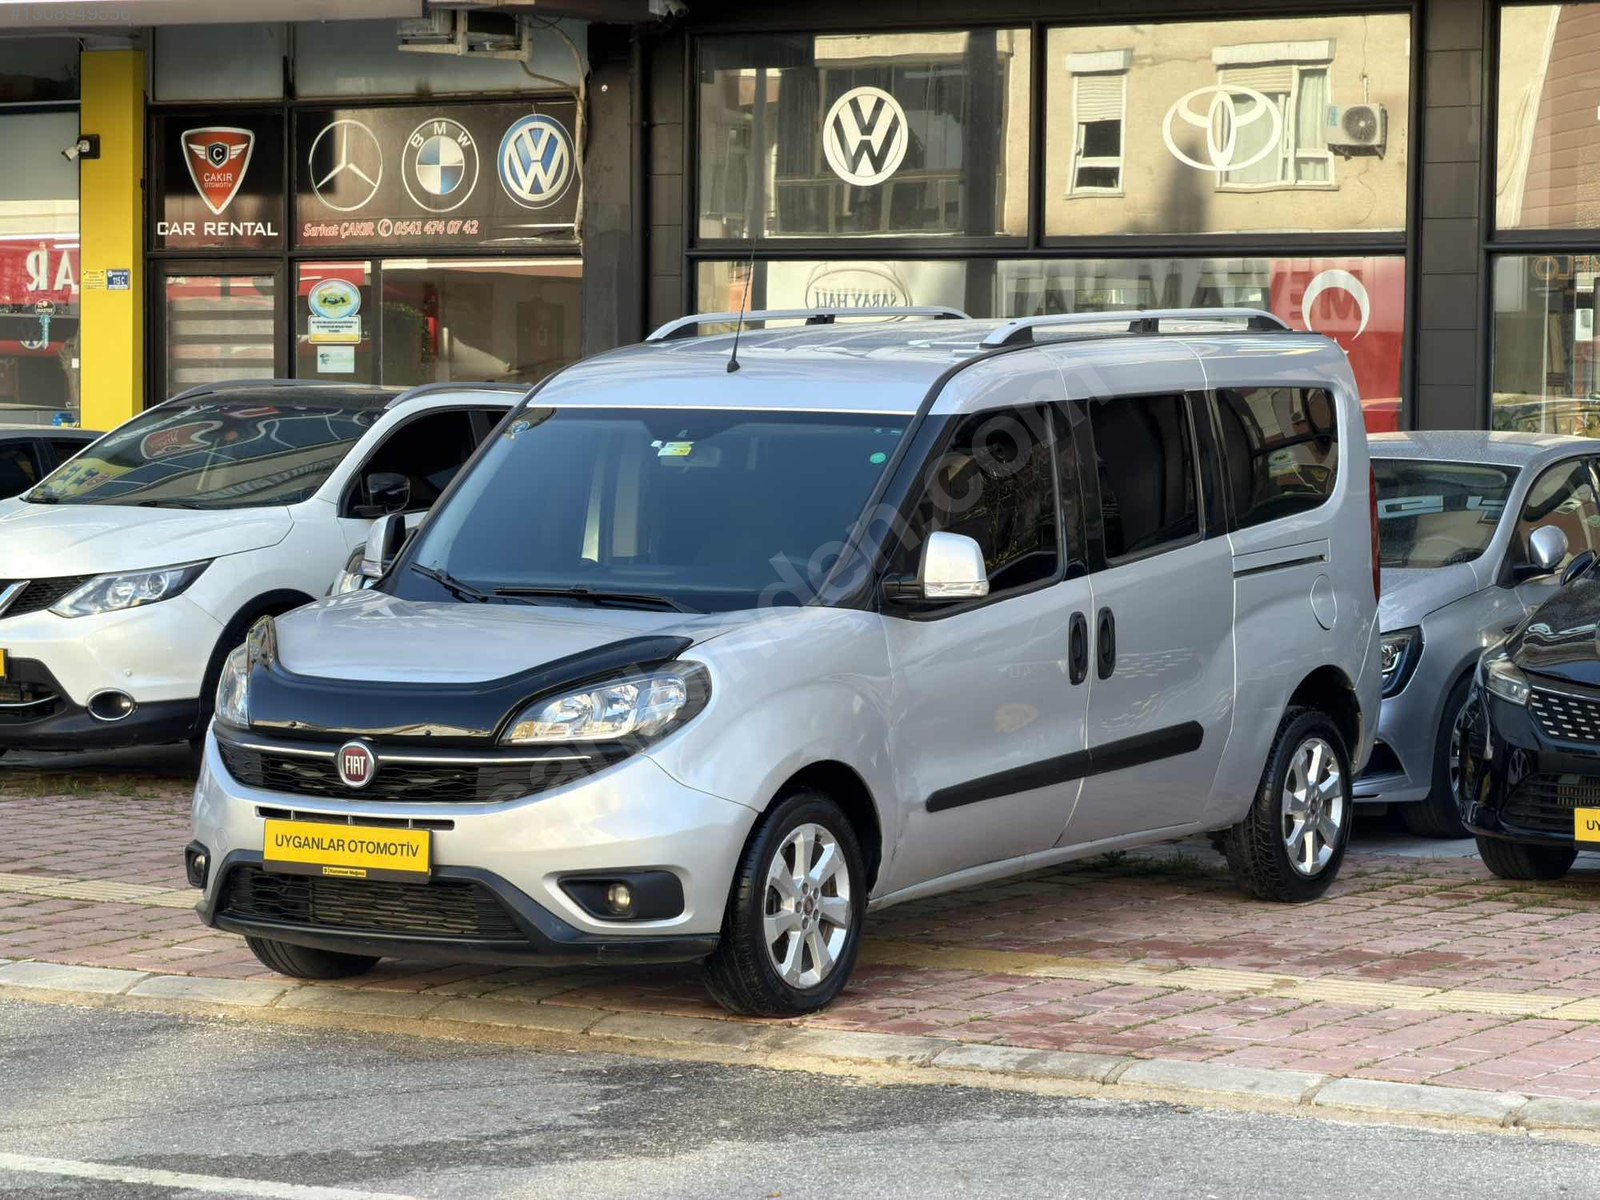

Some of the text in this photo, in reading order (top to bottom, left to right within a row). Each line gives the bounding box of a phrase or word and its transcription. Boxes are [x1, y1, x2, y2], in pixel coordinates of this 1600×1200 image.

[410, 121, 472, 149] BMW
[157, 221, 279, 236] CAR RENTAL
[345, 755, 366, 775] FIAT
[275, 834, 420, 858] UYGANLAR OTOMOTİV
